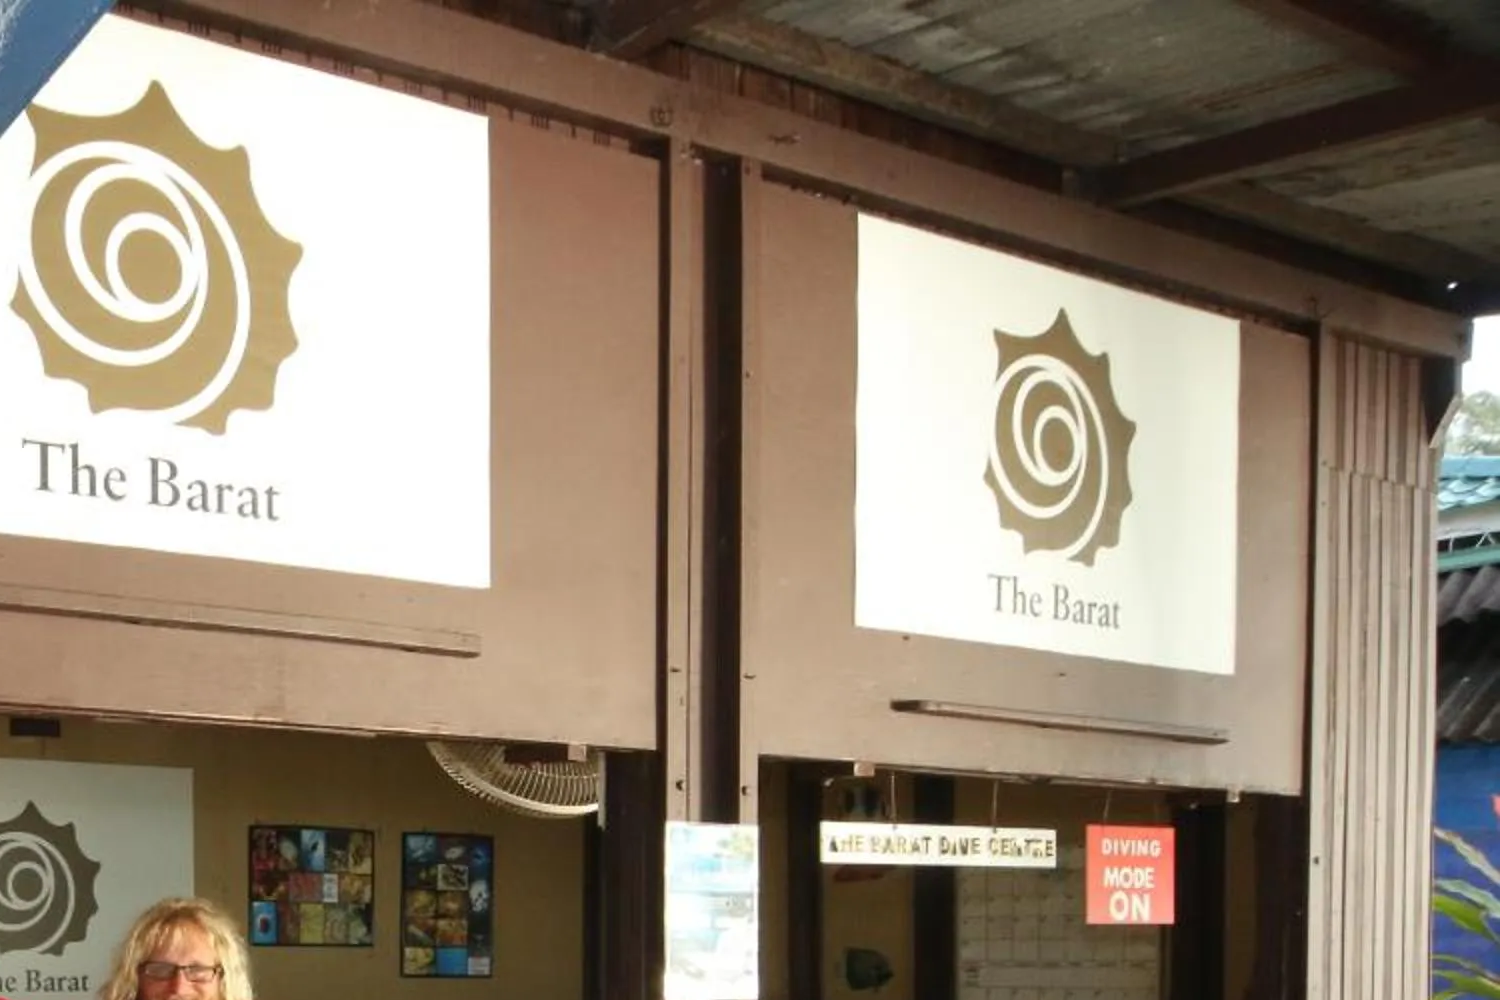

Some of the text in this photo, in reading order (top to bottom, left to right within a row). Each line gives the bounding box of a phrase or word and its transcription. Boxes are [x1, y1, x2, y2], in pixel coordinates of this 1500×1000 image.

[20, 437, 281, 522] The Barat
[987, 573, 1121, 630] The Barat
[939, 836, 980, 855] DIVE
[1101, 837, 1162, 858] DIVING
[1103, 867, 1155, 889] MODE
[1109, 891, 1151, 921] ON
[26, 969, 89, 994] Barat
